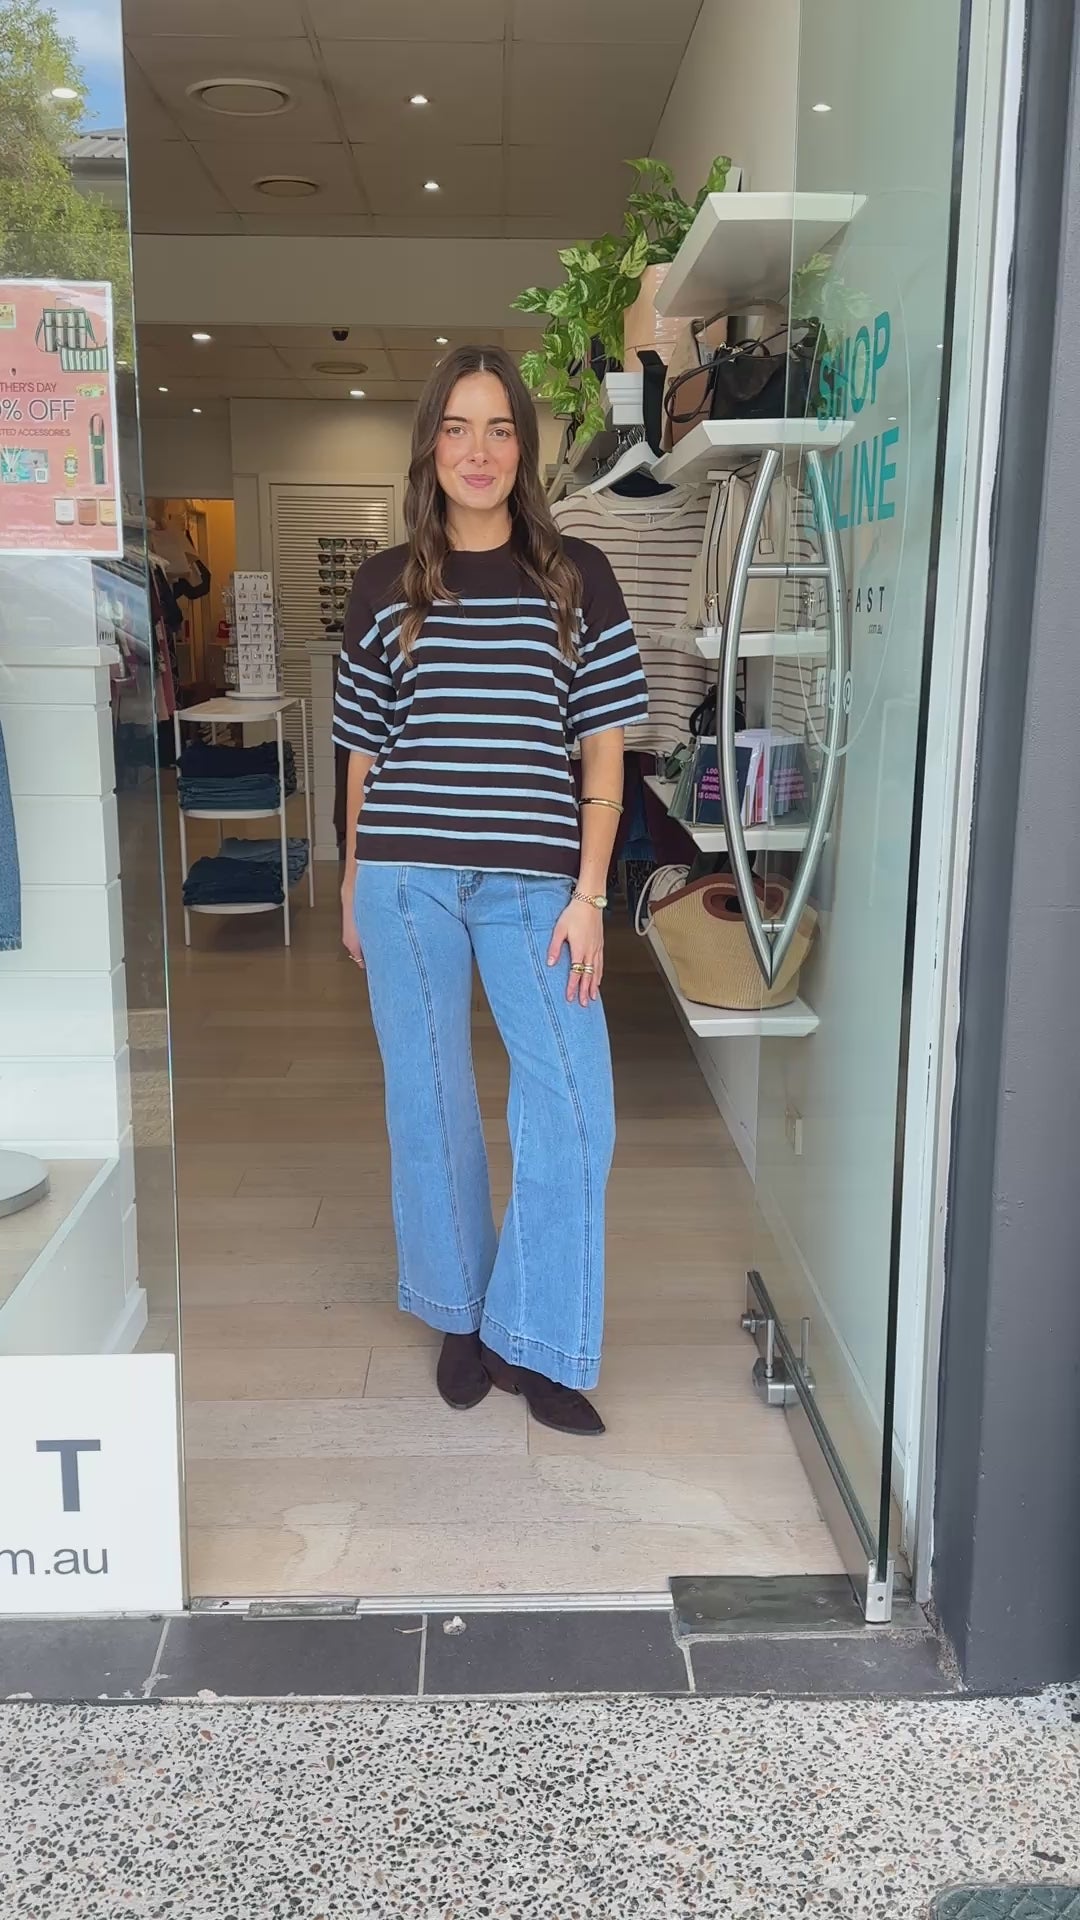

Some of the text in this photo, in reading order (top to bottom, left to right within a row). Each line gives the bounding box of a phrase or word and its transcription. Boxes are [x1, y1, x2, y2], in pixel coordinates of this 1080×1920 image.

[818, 311, 890, 431] SHOP
[37, 382, 57, 392] DAY
[29, 400, 75, 420] OFF
[0, 428, 71, 437] TED ACCESSORIES
[804, 427, 899, 536] NLINE
[36, 1439, 101, 1512] T
[0, 1548, 108, 1575] m.au
